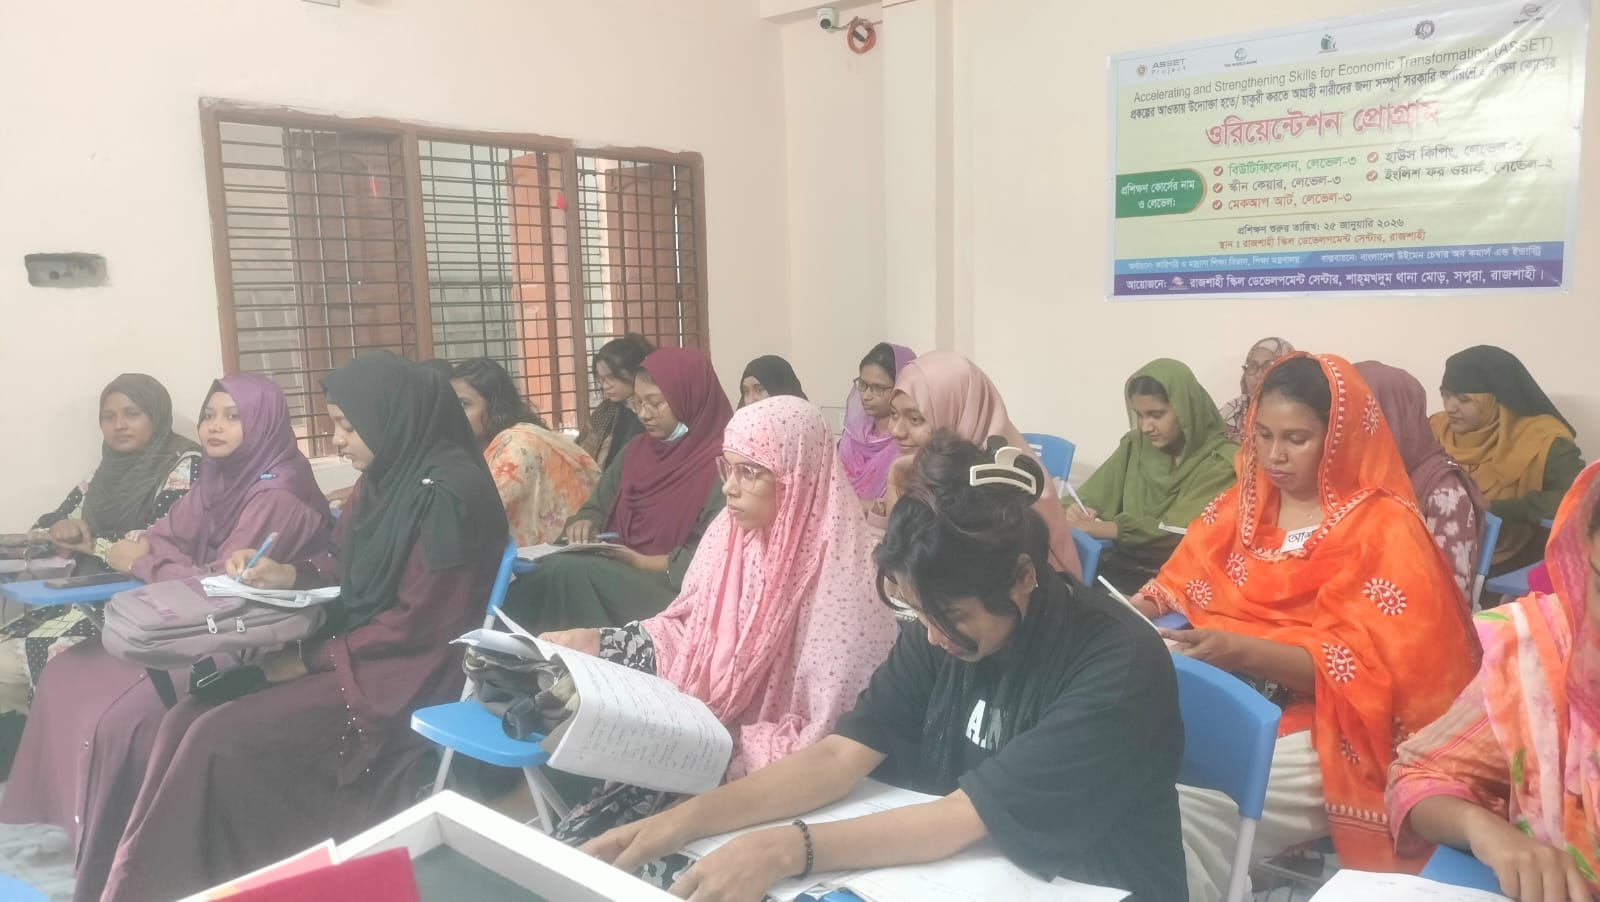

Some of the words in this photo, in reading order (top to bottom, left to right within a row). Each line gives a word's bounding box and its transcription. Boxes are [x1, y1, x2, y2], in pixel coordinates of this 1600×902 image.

[1134, 86, 1190, 103] Accelerating
[1193, 81, 1212, 93] and
[1215, 73, 1286, 94] Strengthening
[1289, 69, 1317, 82] Skills
[1321, 66, 1335, 78] for
[1338, 58, 1394, 77] Economic
[1494, 36, 1553, 59] (ASSET)
[1152, 58, 1187, 68] ASSET
[1157, 102, 1185, 115] আওতায়
[1292, 82, 1316, 100] আগ্রহী
[1320, 80, 1352, 96] নারীদের
[1355, 79, 1371, 91] জন্য
[1376, 75, 1400, 92] সম্পূর্ণ
[1403, 70, 1436, 87] সরকারি
[1205, 108, 1344, 147] ওরিয়েন্টেশন
[1385, 148, 1415, 164] হাউস
[1229, 160, 1302, 177] বিউটিফিকেশন,
[1306, 156, 1357, 170] লেভেল-৩
[1384, 165, 1421, 182] ইংলিশ
[1426, 166, 1445, 178] ফর
[1121, 182, 1149, 195] প্রশিক্ষণ
[1151, 180, 1178, 193] কোর্সের
[1181, 180, 1195, 190] নাম
[1252, 177, 1287, 191] কেয়ার,
[1291, 175, 1342, 188] লেভেল-৩
[1138, 201, 1144, 209] ও
[1228, 196, 1269, 210] মেকআপ
[1274, 193, 1297, 208] আর্ট,
[1302, 191, 1352, 205] লেভেল-৩
[1238, 223, 1267, 235] প্রশিক্ষণ
[1269, 222, 1289, 234] শুরুর
[1292, 221, 1320, 232] তারিখ:
[1323, 221, 1336, 231] ২৫
[1340, 217, 1374, 231] জানুয়ারি
[1377, 218, 1404, 228] ২০২৬
[1219, 240, 1233, 250] স্থান
[1243, 236, 1274, 248] রাজশাহী
[1298, 233, 1350, 245] ডেভেলপমেন্ট
[1355, 232, 1385, 243] সেন্টার,
[1390, 229, 1426, 241] রাজশাহী
[1126, 279, 1167, 290] আয়োজনে:
[1190, 275, 1224, 289] রাজশাহী
[1248, 272, 1305, 288] ডেভেলপমেন্ট
[1308, 272, 1342, 285] সেন্টার,
[1396, 272, 1417, 283] থানা
[1422, 272, 1449, 284] মোড়,
[1454, 270, 1486, 284] সপুরা,
[1490, 266, 1537, 281] রাজশাহী
